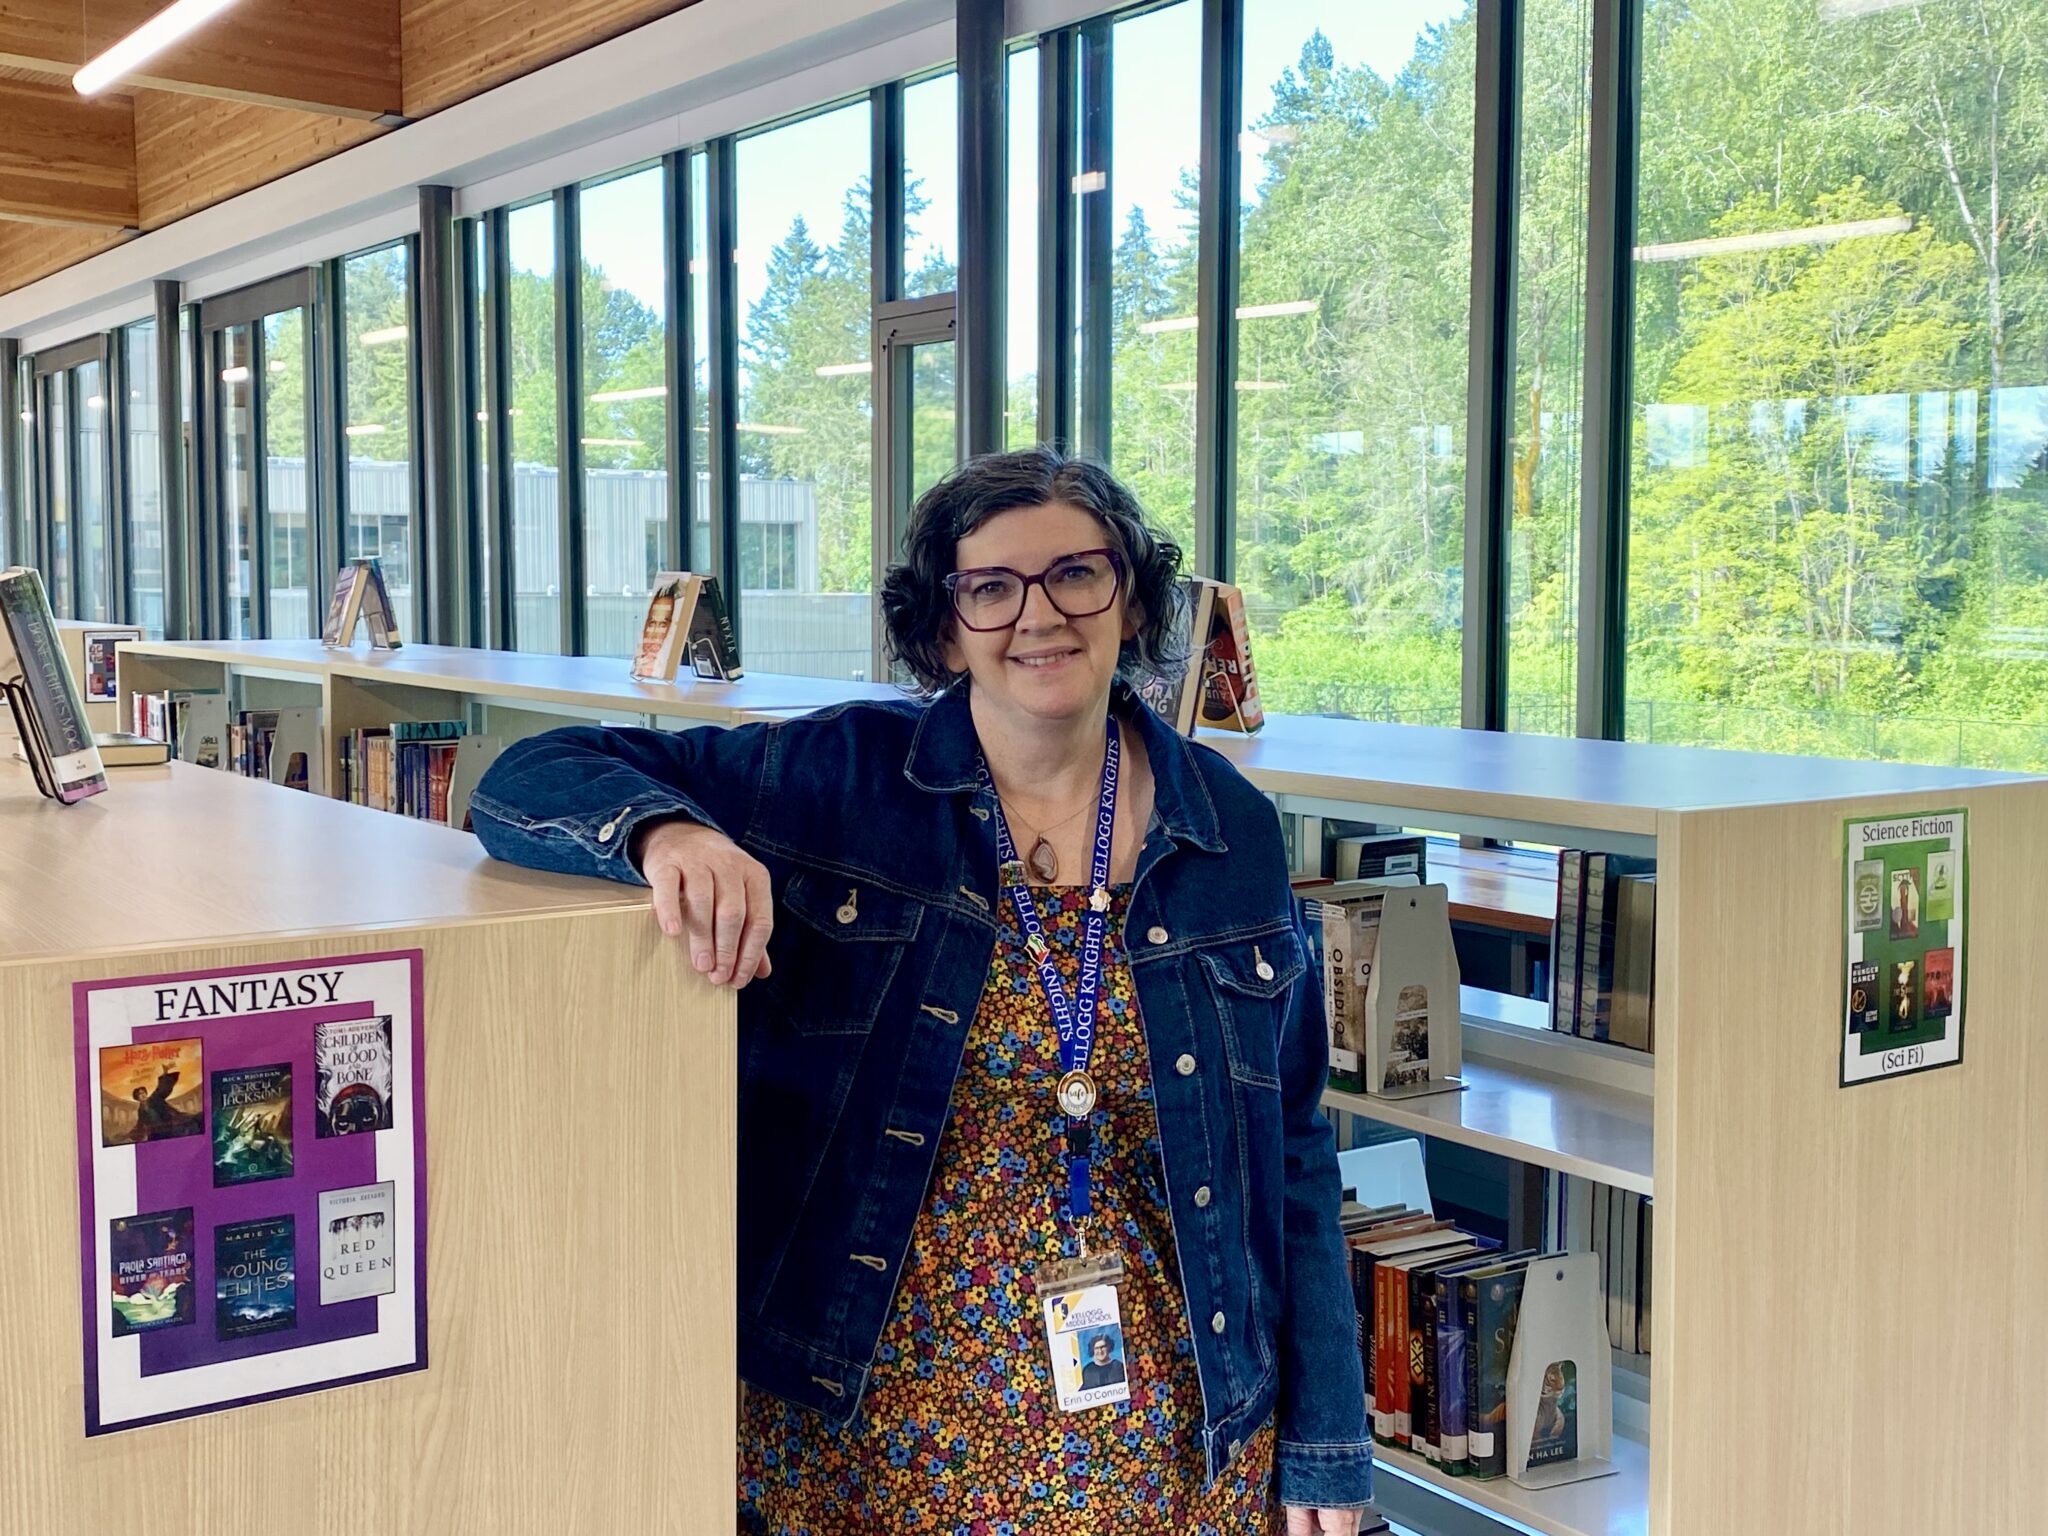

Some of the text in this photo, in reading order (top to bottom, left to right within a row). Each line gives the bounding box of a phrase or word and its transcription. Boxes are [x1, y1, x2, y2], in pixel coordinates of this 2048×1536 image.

[720, 616, 736, 653] NYXIA
[60, 715, 81, 752] MOO
[401, 721, 467, 739] READY
[1093, 738, 1119, 891] KELLOGG KNIGHTS
[1862, 819, 1954, 842] Science Fiction
[154, 971, 345, 1021] FANTASY
[1039, 961, 1074, 1042] KNIGHTS
[1073, 917, 1102, 1072] ELLOGG KNIGHTS
[1332, 948, 1346, 1035] OBSIDIO
[324, 1031, 383, 1048] CHILDREN
[332, 1048, 378, 1066] BLOOD
[1881, 1045, 1925, 1073] (Sci Fi)
[337, 1067, 374, 1085] BONE
[222, 1086, 282, 1110] JACKSON
[225, 1230, 263, 1242] MARIE
[340, 1239, 376, 1255] RED
[119, 1252, 187, 1275] PAOLA SANTIAGO
[244, 1248, 267, 1260] THE
[223, 1257, 289, 1279] YOUNG
[323, 1256, 392, 1281] QUEEN
[225, 1273, 289, 1300] ELITES
[1410, 1335, 1424, 1377] EXO
[1063, 1387, 1127, 1407] Erin O'Connor
[1536, 1449, 1548, 1460] HA
[1551, 1446, 1564, 1457] LEE
